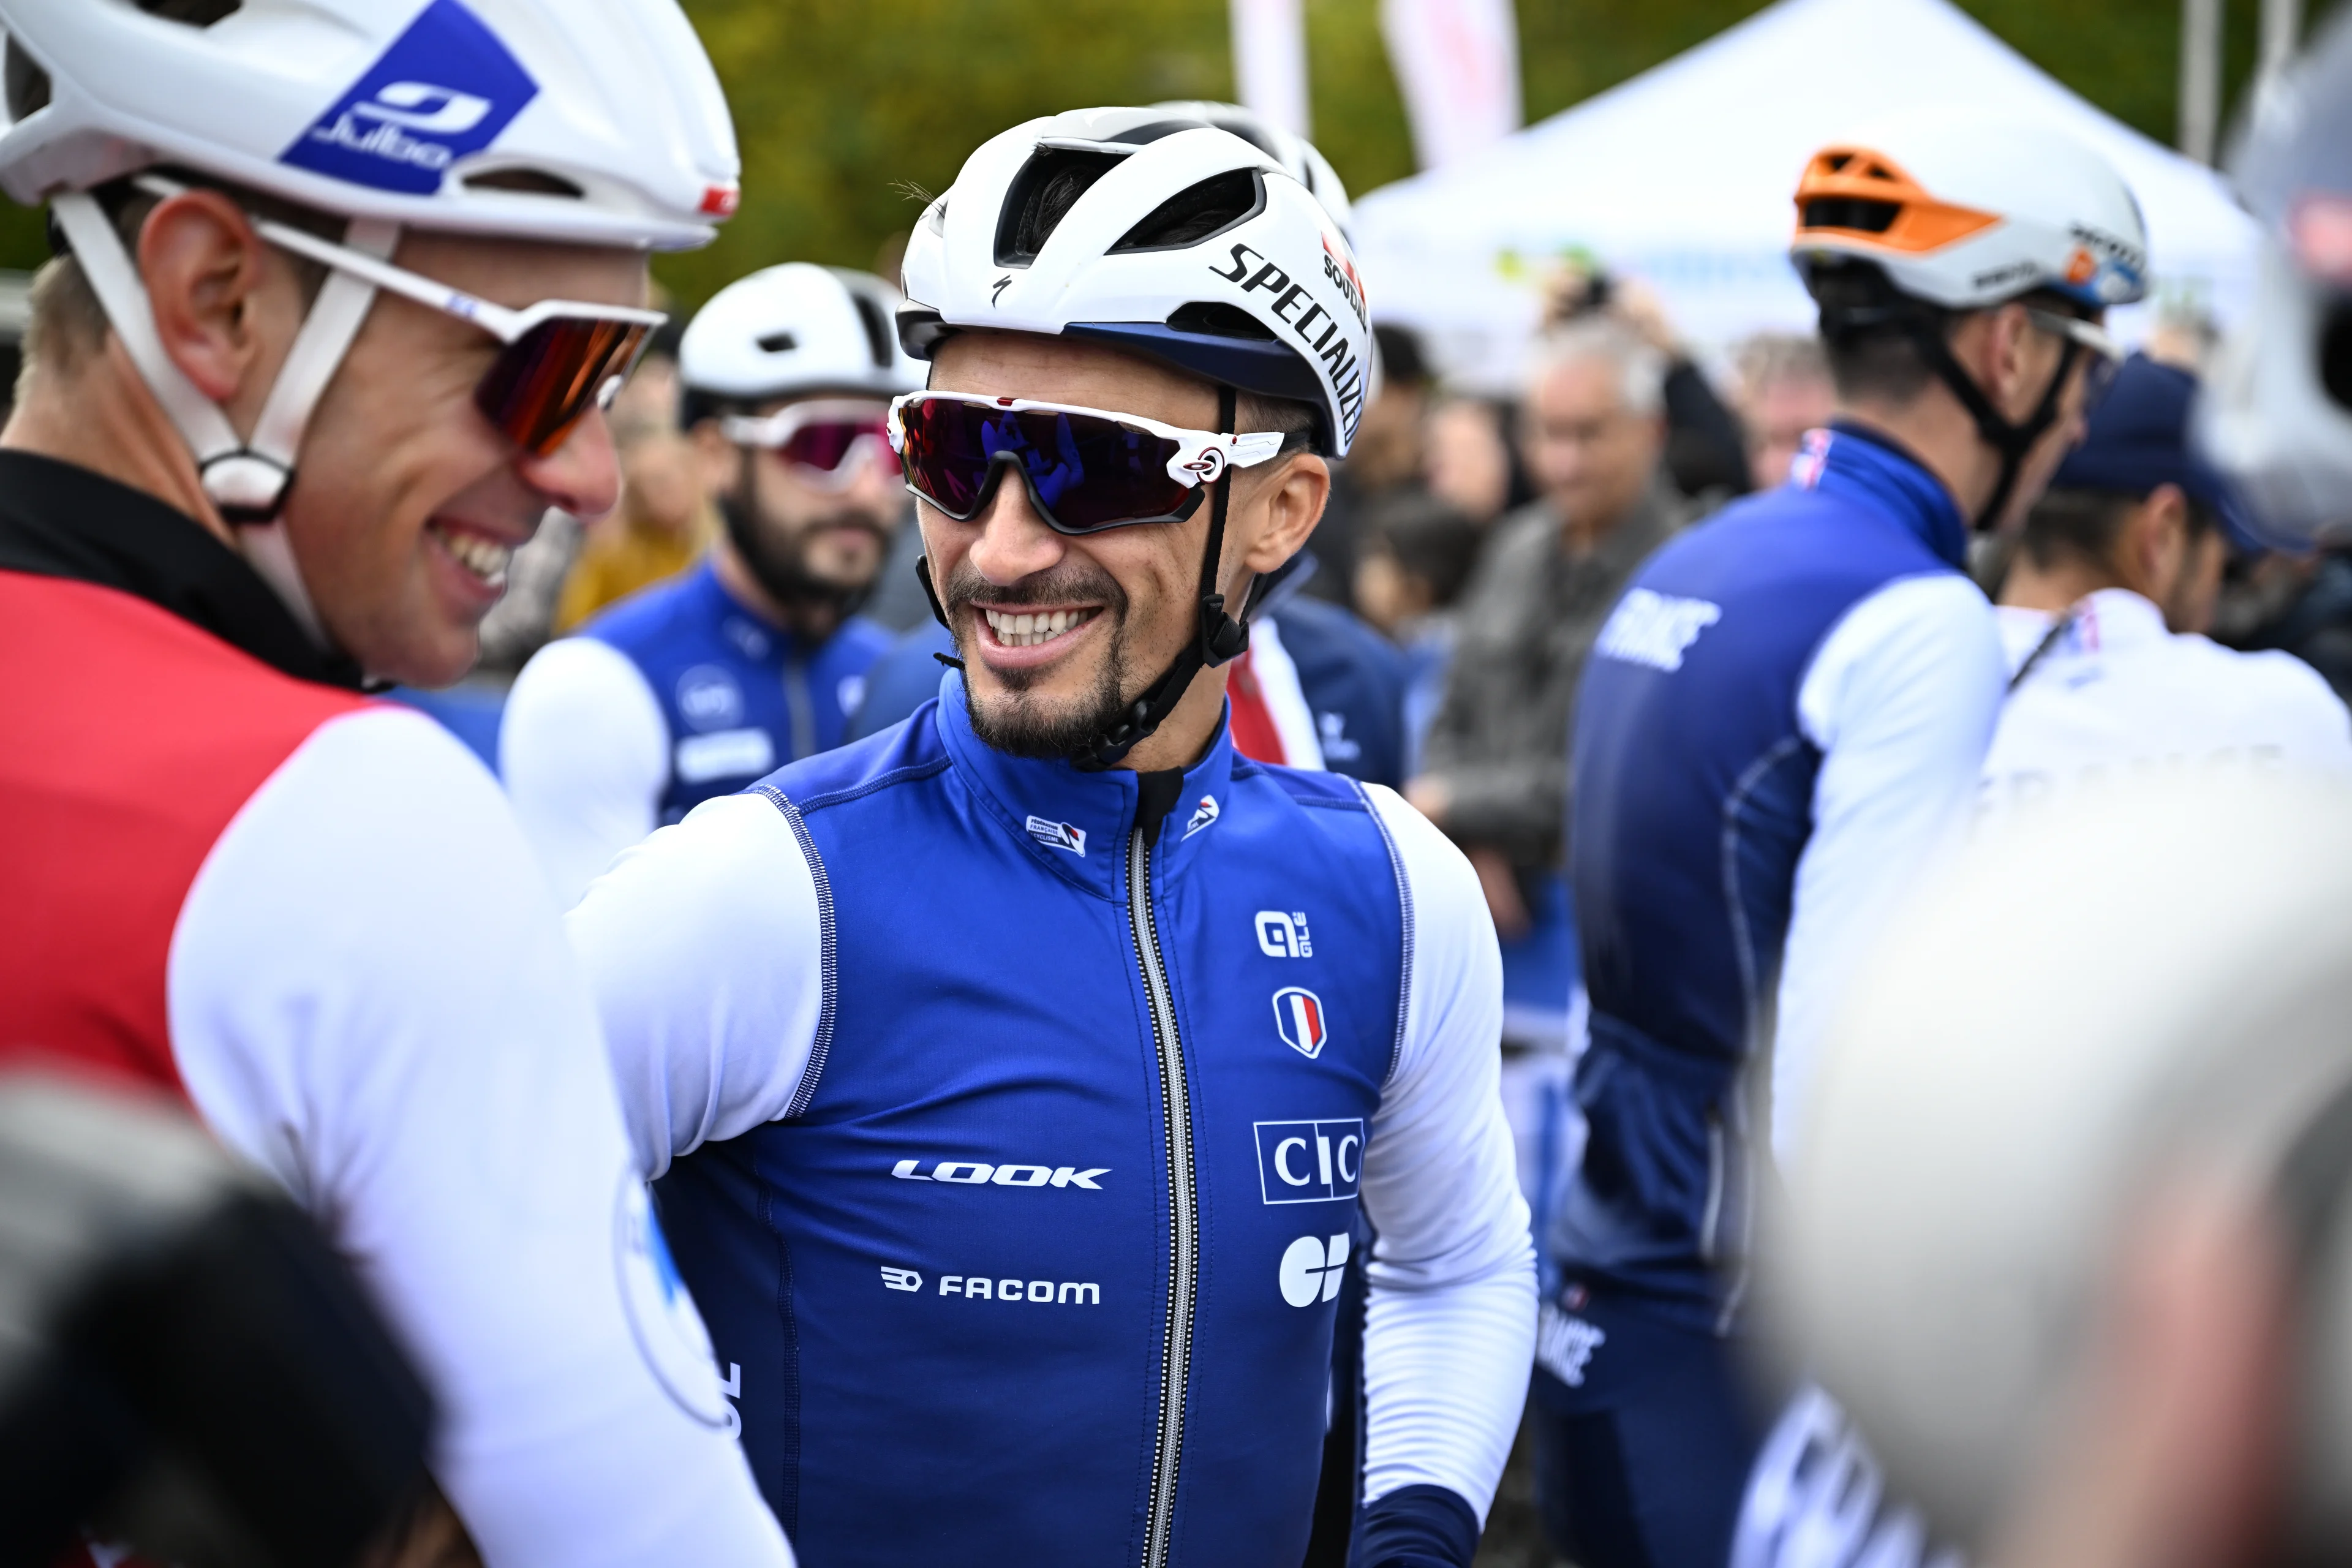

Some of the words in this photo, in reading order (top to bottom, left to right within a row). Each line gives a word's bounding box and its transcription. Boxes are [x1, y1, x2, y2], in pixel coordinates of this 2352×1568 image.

[1324, 254, 1367, 334] SOUDAL
[1030, 824, 1058, 835] FRANÇAISE
[1033, 833, 1059, 843] CYCLISME
[891, 1159, 1113, 1189] LOOK
[1275, 1134, 1359, 1186] CIC
[939, 1275, 1100, 1305] FACOM
